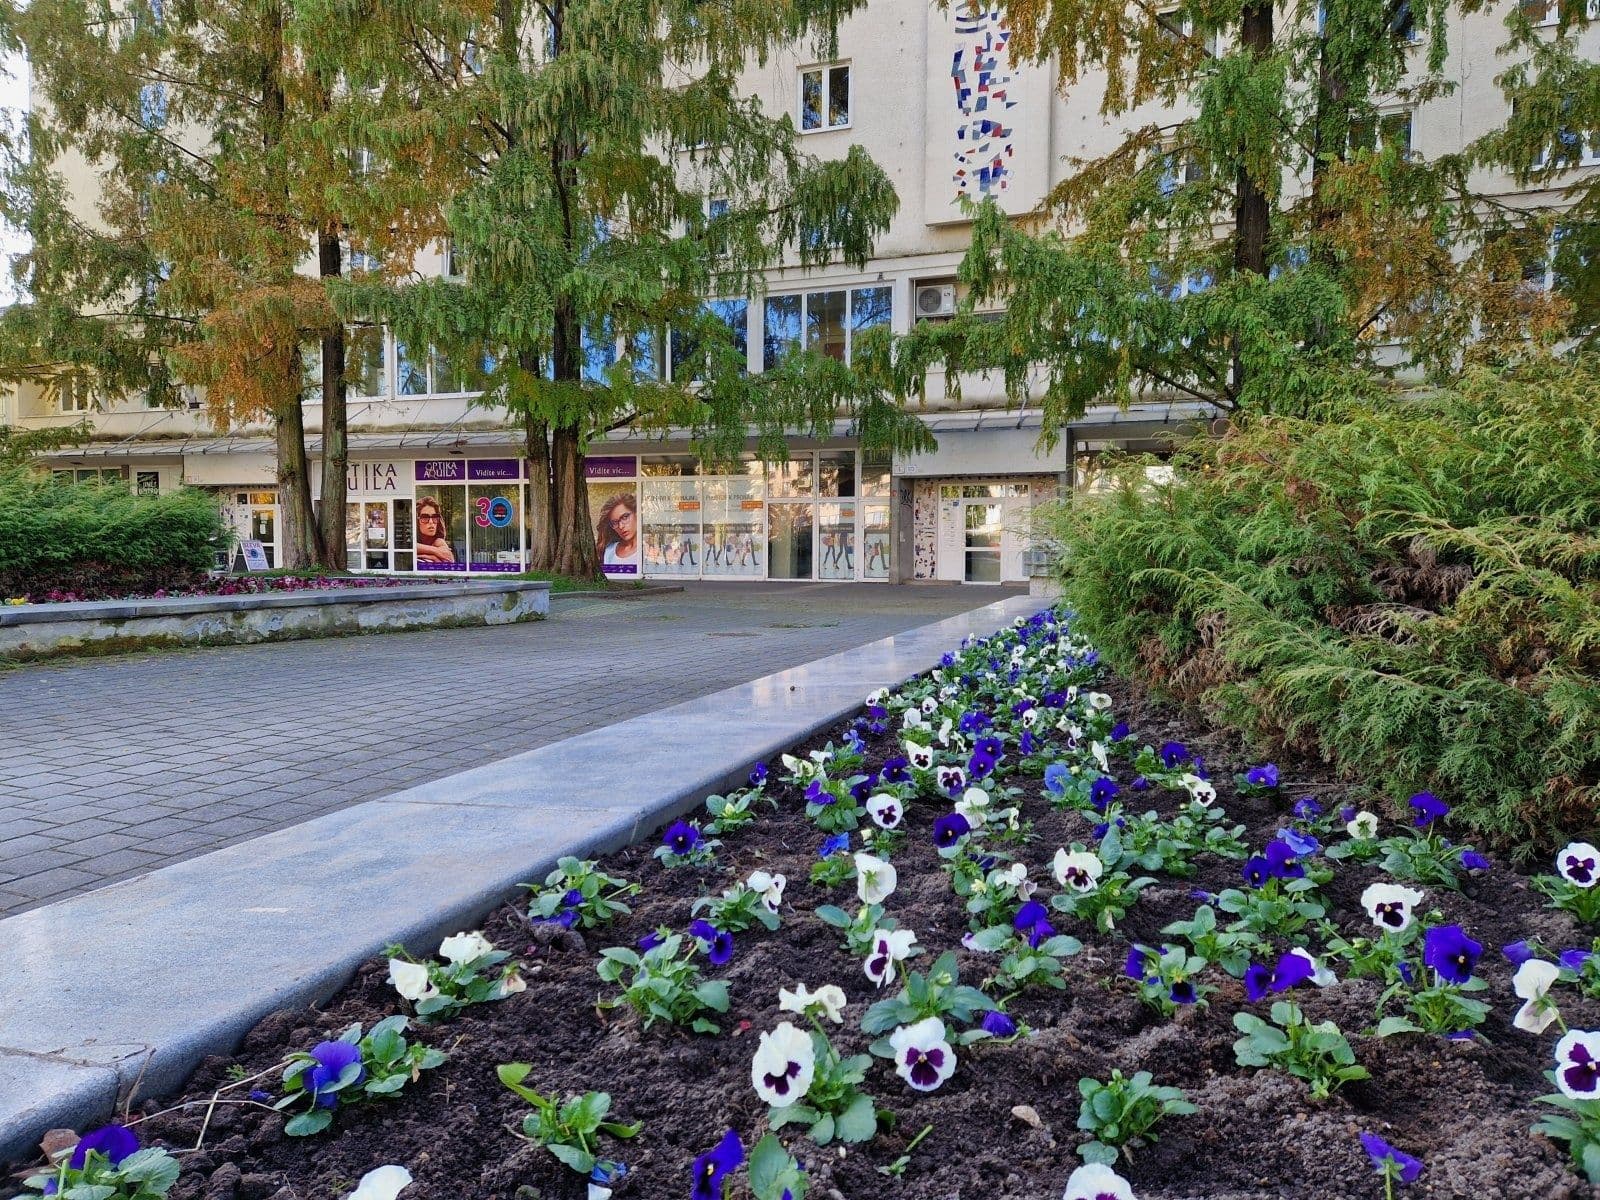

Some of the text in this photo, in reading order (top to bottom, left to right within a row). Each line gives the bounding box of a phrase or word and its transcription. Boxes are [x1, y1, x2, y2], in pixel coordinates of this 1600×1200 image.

[346, 463, 397, 477] TIKA
[425, 462, 458, 470] OPTIKA
[423, 468, 457, 479] AQUILA
[347, 477, 396, 490] UILA
[475, 496, 513, 528] 30
